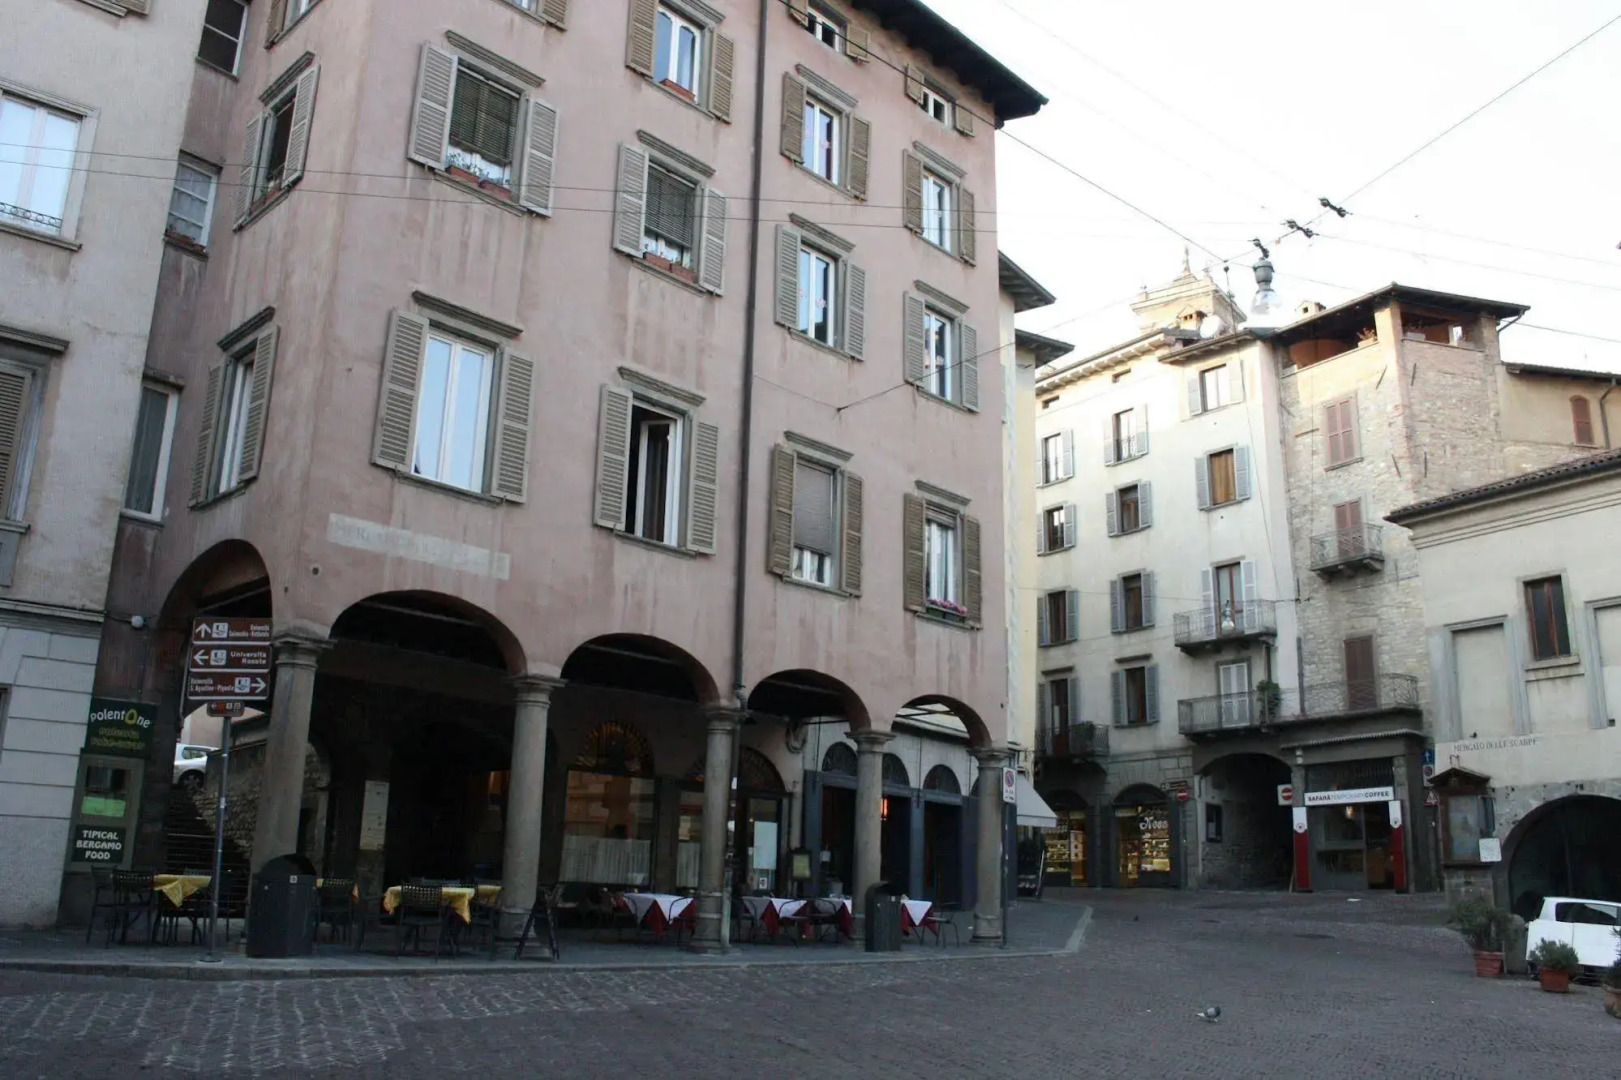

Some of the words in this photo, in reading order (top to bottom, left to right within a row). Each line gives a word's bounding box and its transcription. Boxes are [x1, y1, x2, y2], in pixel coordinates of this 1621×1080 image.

[82, 830, 118, 840] TIPICAL
[76, 840, 122, 850] BERGAMO
[85, 850, 110, 860] FOOD
